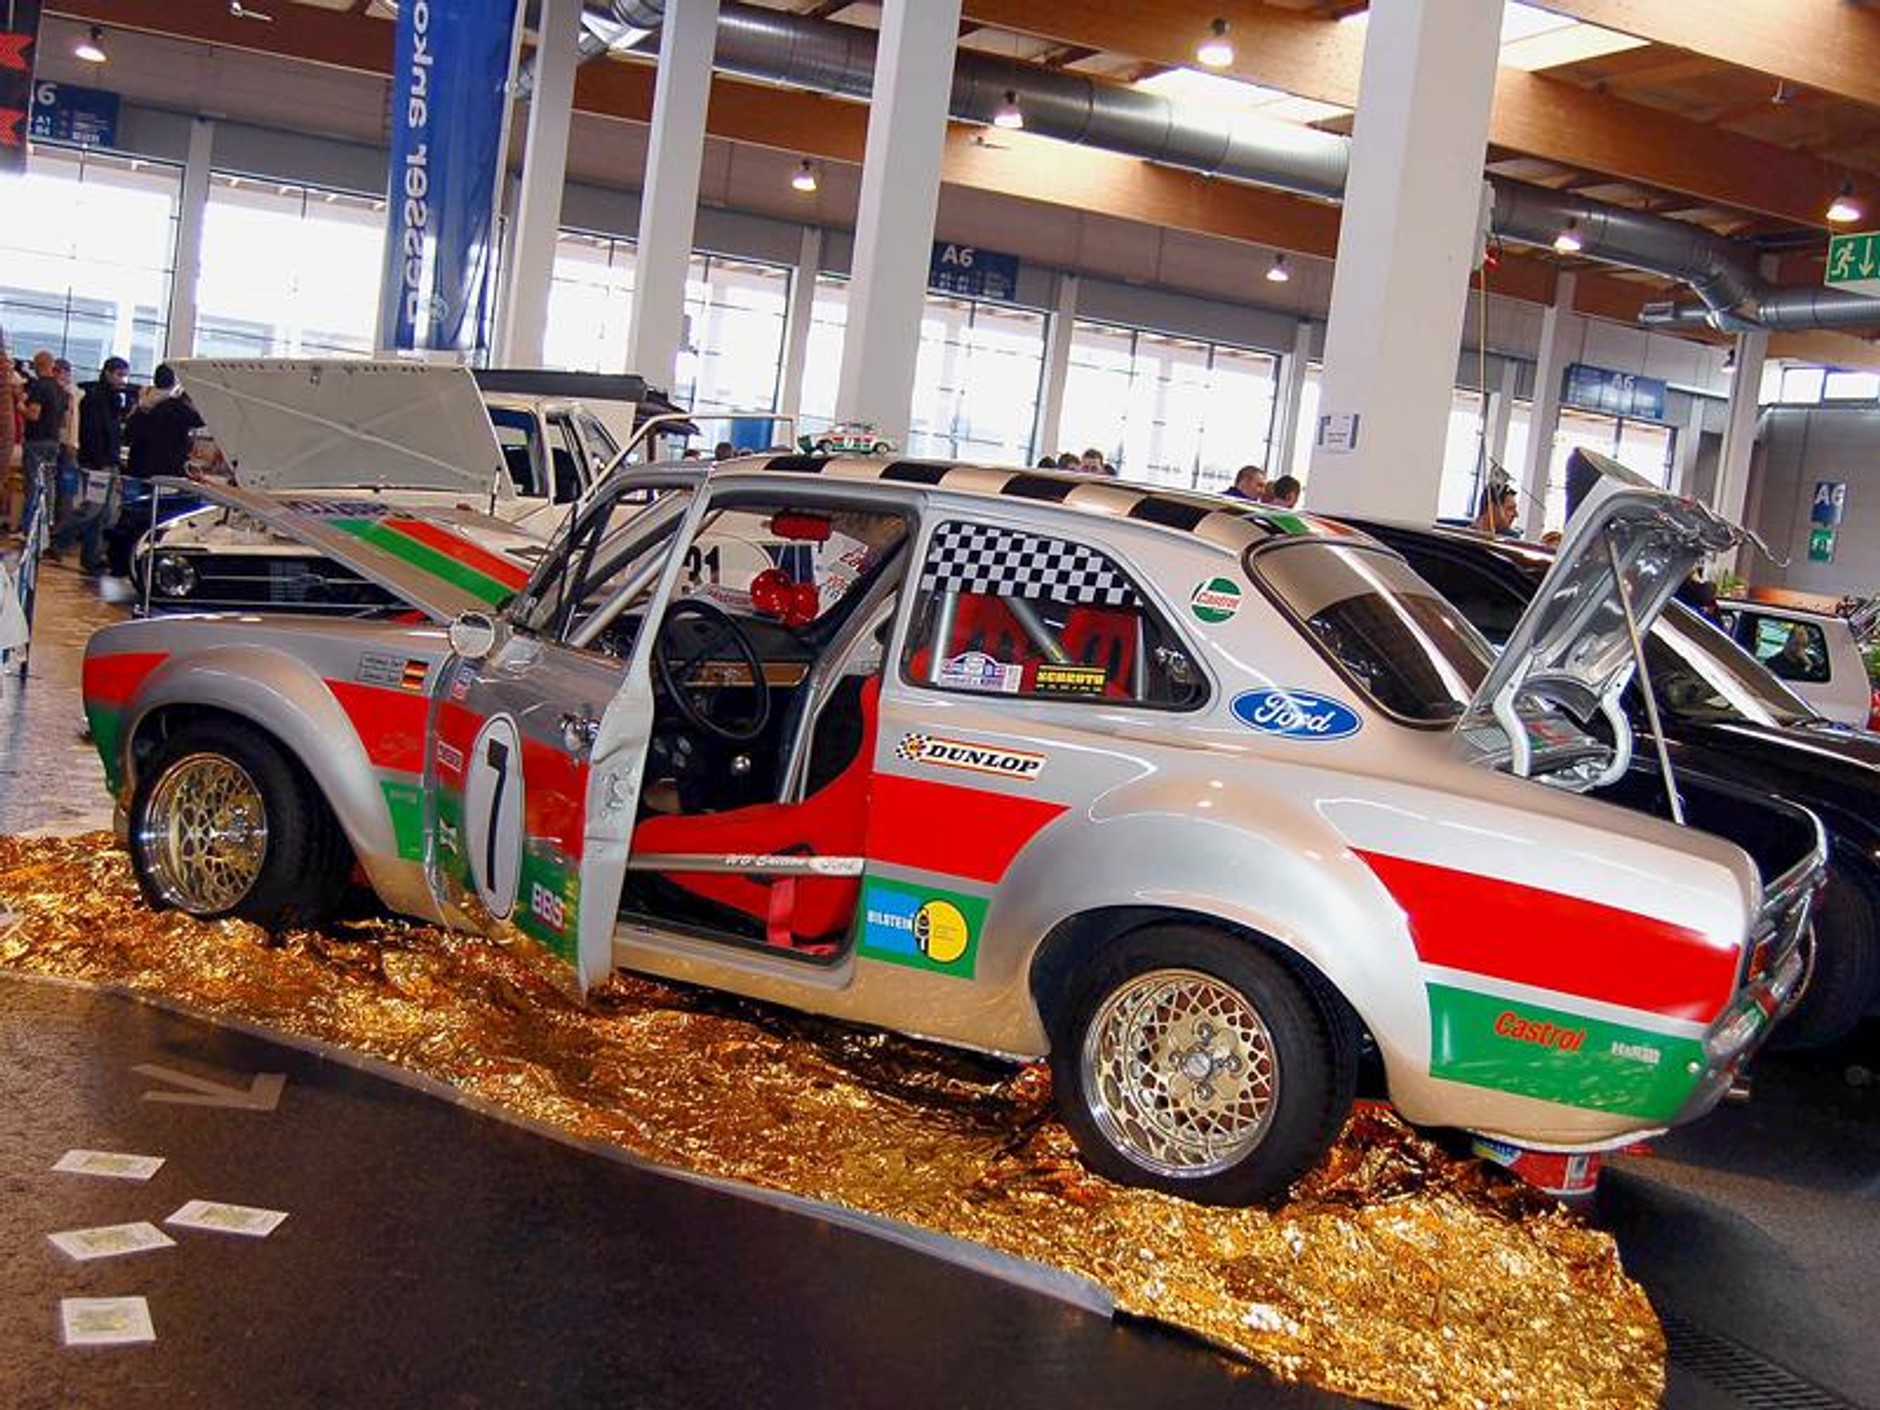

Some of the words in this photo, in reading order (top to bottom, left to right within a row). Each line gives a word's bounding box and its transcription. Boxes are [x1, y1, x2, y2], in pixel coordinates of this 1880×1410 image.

[37, 82, 58, 106] 6
[941, 244, 975, 268] A6
[1611, 372, 1635, 391] A6
[1814, 484, 1846, 506] A6
[1254, 692, 1336, 732] Ford
[926, 744, 1040, 772] DUNLOP
[531, 881, 564, 927] BBS
[866, 909, 913, 931] BILSTEIN
[1495, 1011, 1586, 1052] Castrol
